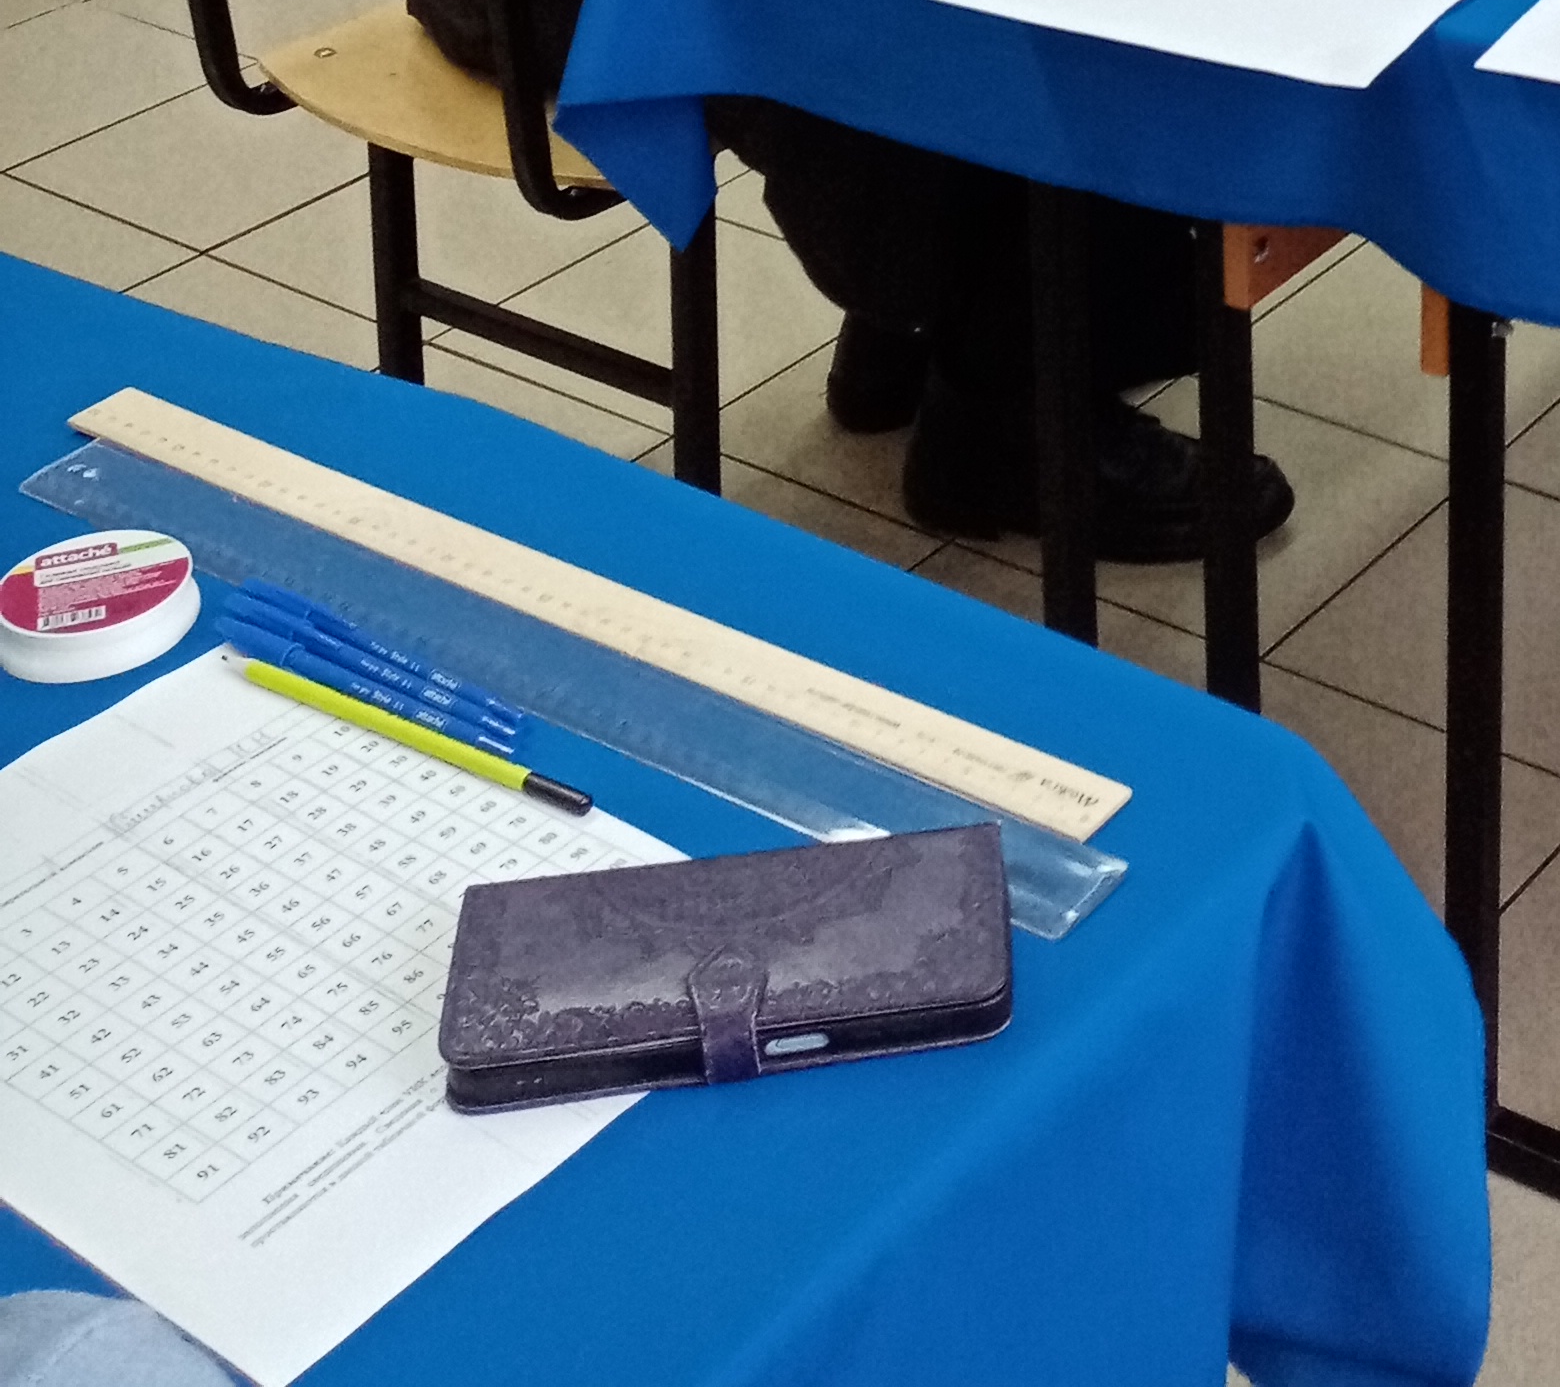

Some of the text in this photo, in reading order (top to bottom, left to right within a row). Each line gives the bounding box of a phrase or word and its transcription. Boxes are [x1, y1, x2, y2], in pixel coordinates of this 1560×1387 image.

[40, 544, 113, 567] attaché
[0, 740, 380, 987] 12 13 14 15 16 17 18 19 20
[6, 1045, 28, 1061] 31
[57, 1009, 81, 1024] 32
[108, 975, 130, 991] 33
[157, 943, 179, 959] 34
[203, 911, 225, 927] 35
[248, 881, 270, 897] 36
[293, 851, 312, 866] 37
[336, 822, 357, 837] 38
[26, 991, 50, 1008] 22
[78, 957, 100, 973] 23
[126, 925, 149, 941] 24
[174, 894, 195, 910] 25
[219, 865, 240, 879] 26
[263, 835, 282, 850] 27
[307, 806, 327, 820] 28
[349, 779, 367, 792] 29
[39, 1064, 60, 1079] 41
[91, 1028, 112, 1044] 42
[141, 994, 161, 1009] 43
[190, 961, 209, 976] 44
[237, 928, 255, 943] 45
[282, 898, 300, 913] 46
[326, 867, 341, 882] 47
[369, 839, 386, 852] 48
[410, 810, 426, 824] 49
[69, 1083, 91, 1099] 51
[120, 1047, 142, 1064] 52
[170, 1013, 192, 1029] 53
[219, 979, 240, 995] 54
[265, 946, 286, 961] 55
[310, 916, 331, 932] 56
[355, 884, 369, 900] 57
[100, 1103, 123, 1118] 61
[152, 1066, 174, 1082] 62
[202, 1031, 222, 1047] 63
[250, 996, 271, 1012] 64
[297, 964, 316, 979] 65
[341, 933, 361, 948] 66
[386, 901, 402, 916] 67
[428, 870, 447, 885] 68
[130, 1123, 154, 1137] 71
[181, 1086, 206, 1100] 72
[231, 1050, 254, 1064] 73
[280, 1015, 302, 1028] 74
[326, 981, 348, 995] 75
[370, 951, 393, 965] 76
[415, 918, 433, 932] 77
[498, 858, 518, 869] 79
[163, 1143, 186, 1159] 81
[214, 1106, 238, 1122] 82
[263, 1069, 286, 1085] 83
[312, 1034, 334, 1050] 84
[358, 1000, 379, 1015] 85
[403, 969, 424, 984] 86
[196, 1019, 412, 1179] 91 92 93 94 95
